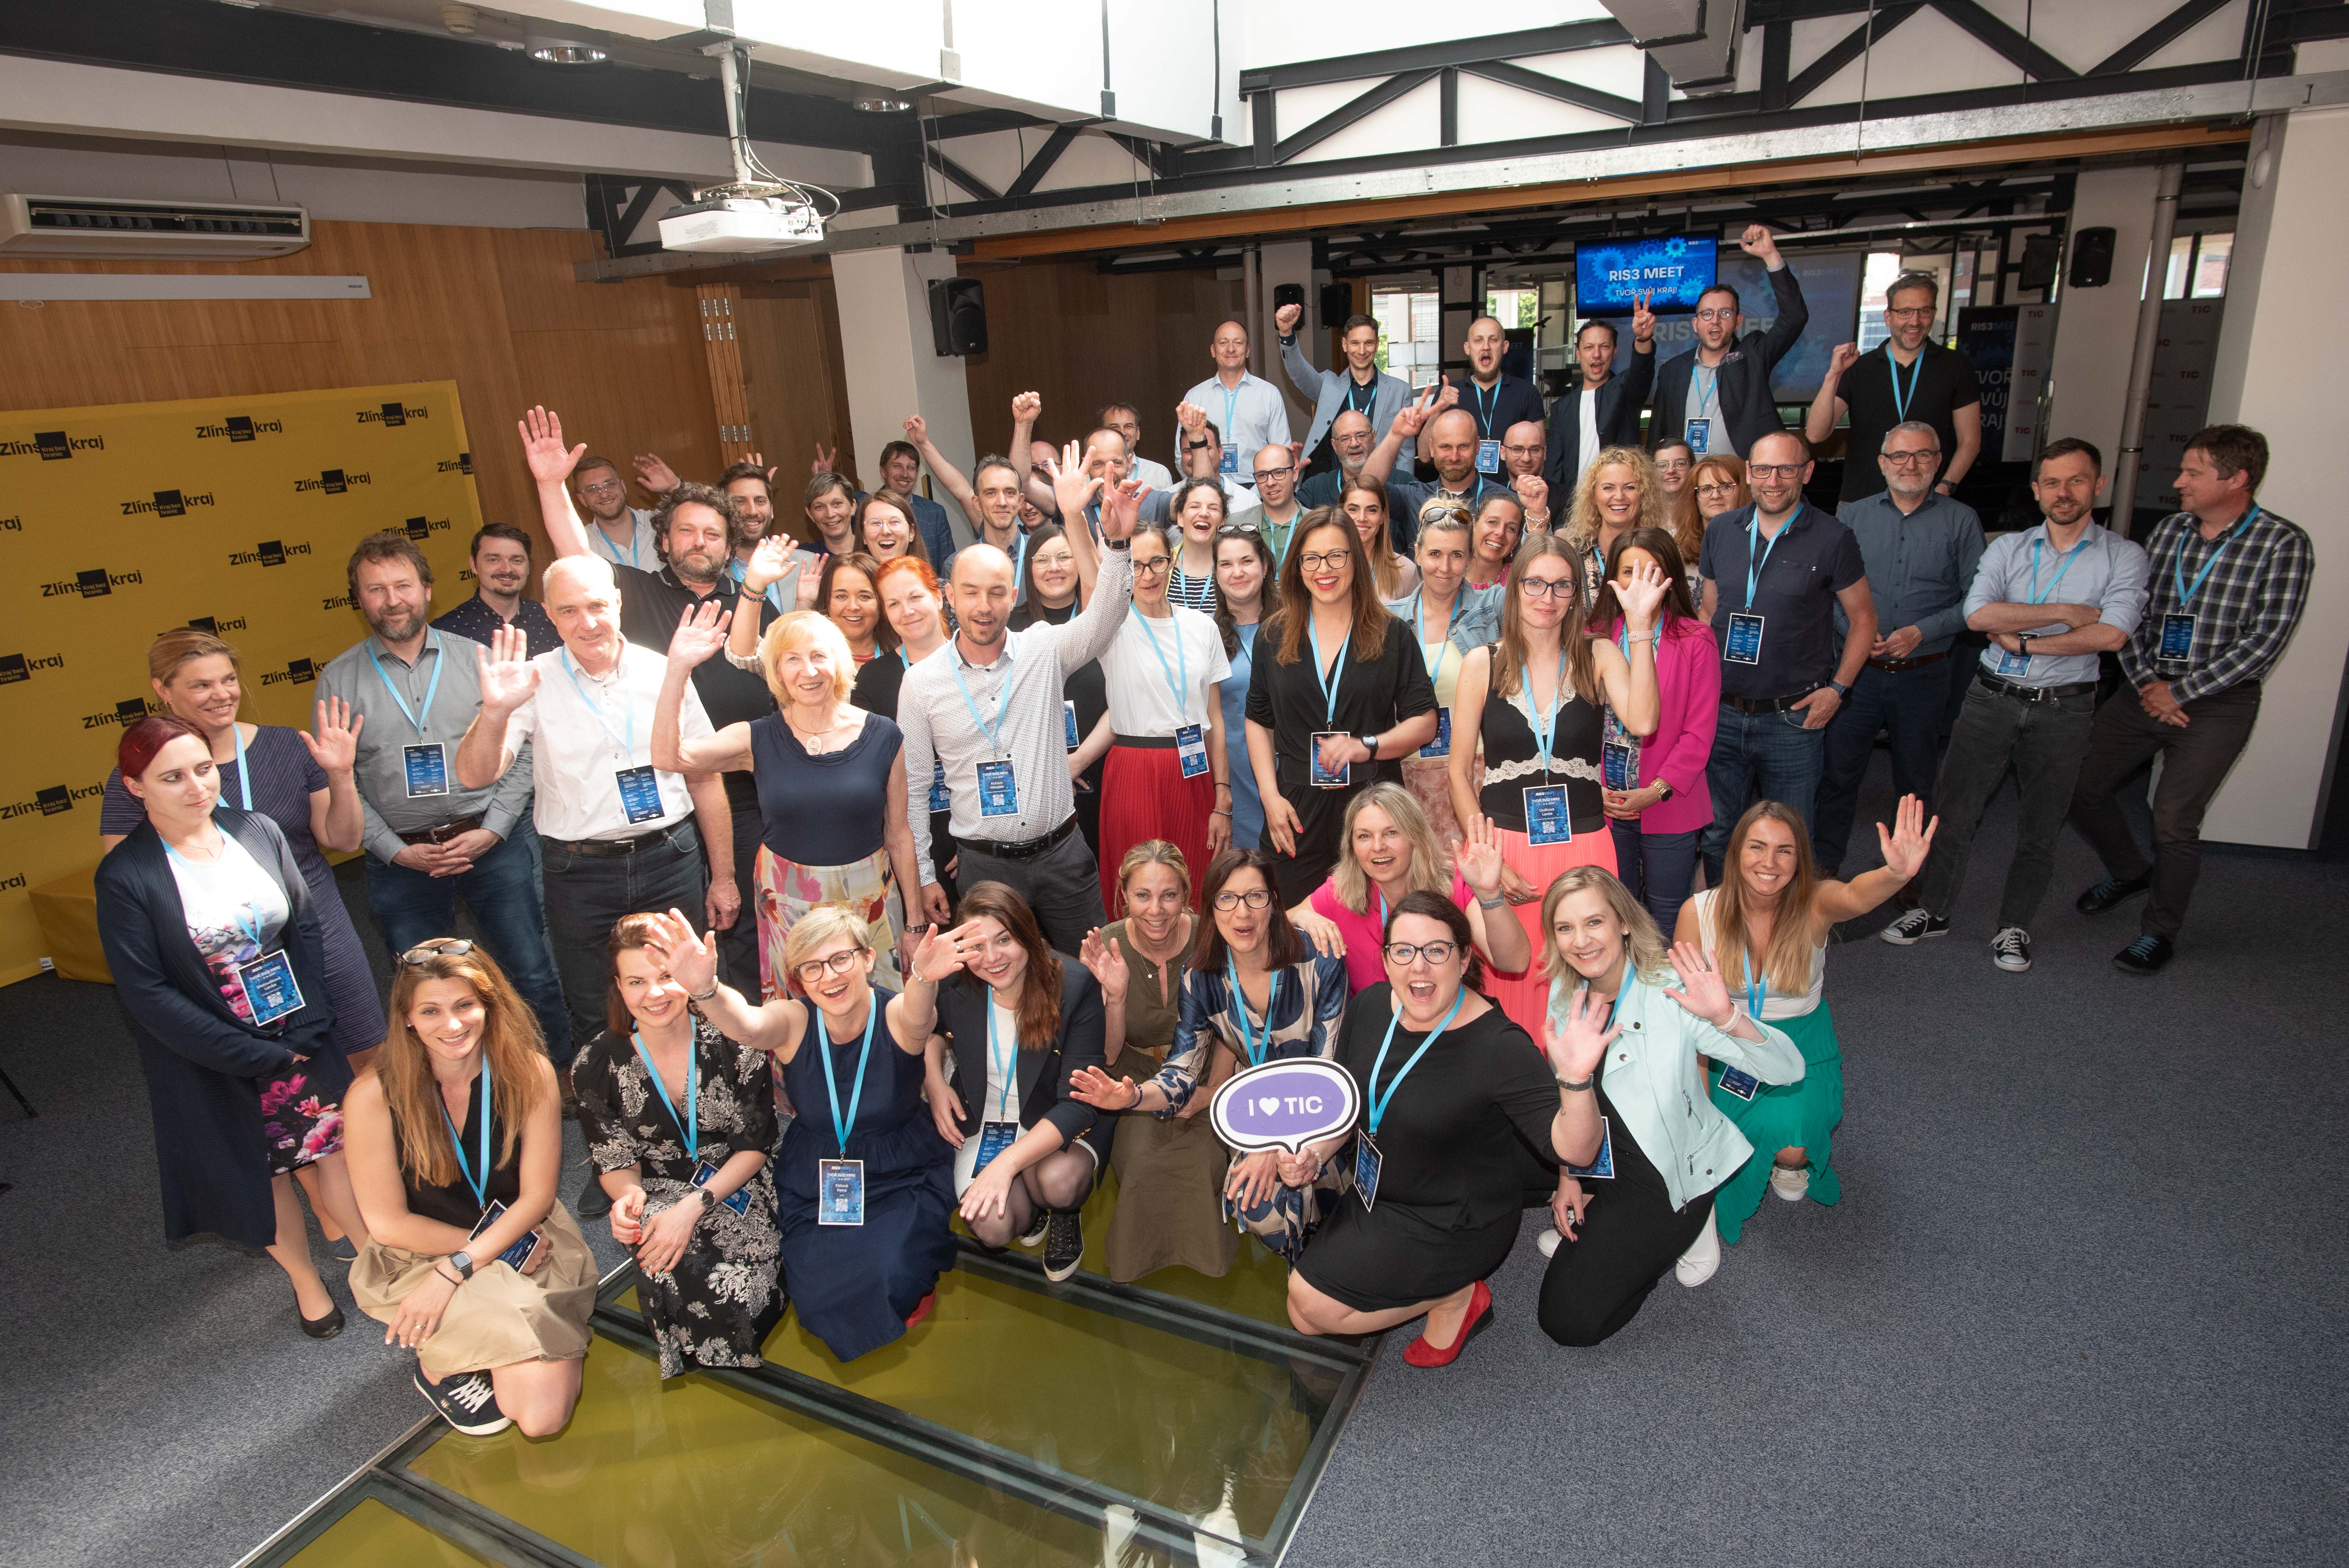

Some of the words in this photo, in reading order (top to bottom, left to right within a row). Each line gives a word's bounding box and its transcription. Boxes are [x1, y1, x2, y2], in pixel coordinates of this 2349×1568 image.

[1609, 269, 1640, 282] RIS3
[1644, 266, 1684, 280] MEET
[1615, 287, 1636, 296] TVOŘ
[1638, 285, 1655, 295] SVŮJ
[1657, 286, 1677, 294] KRAJ!
[1655, 321, 1698, 341] RIS
[1971, 323, 2015, 331] RIS3MEE
[2180, 371, 2199, 379] TIC
[1981, 388, 2008, 408] VŮJ
[405, 406, 428, 419] kraj
[253, 420, 282, 433] kraj
[69, 435, 104, 451] kraj
[345, 472, 371, 485] kraj
[183, 492, 215, 507] kraj
[428, 518, 451, 530] kraj
[284, 542, 312, 556] kraj
[109, 570, 143, 586] kraj
[217, 617, 246, 633] kraj
[27, 654, 64, 671] kraj
[70, 782, 104, 800] kraj
[0, 873, 26, 891] raj
[252, 961, 273, 973] RIS3MEET
[1248, 1099, 1255, 1116] I
[1284, 1096, 1323, 1115] TIC
